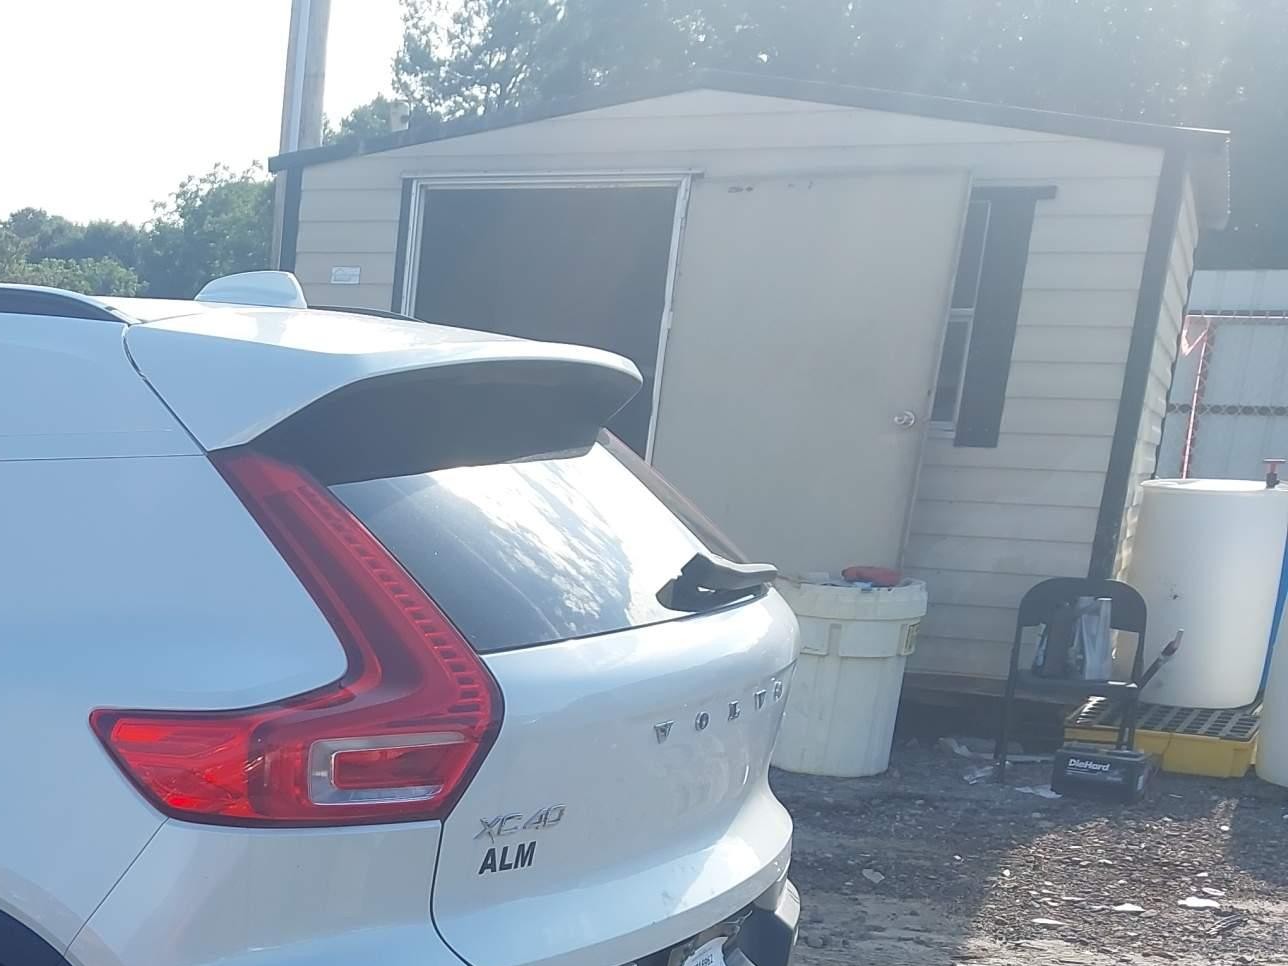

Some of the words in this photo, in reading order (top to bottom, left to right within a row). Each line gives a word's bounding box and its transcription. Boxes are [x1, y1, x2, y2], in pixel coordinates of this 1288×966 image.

[653, 680, 783, 744] VOLVO
[1068, 758, 1111, 771] DieHard
[473, 804, 567, 844] XC40
[478, 840, 537, 875] ALM
